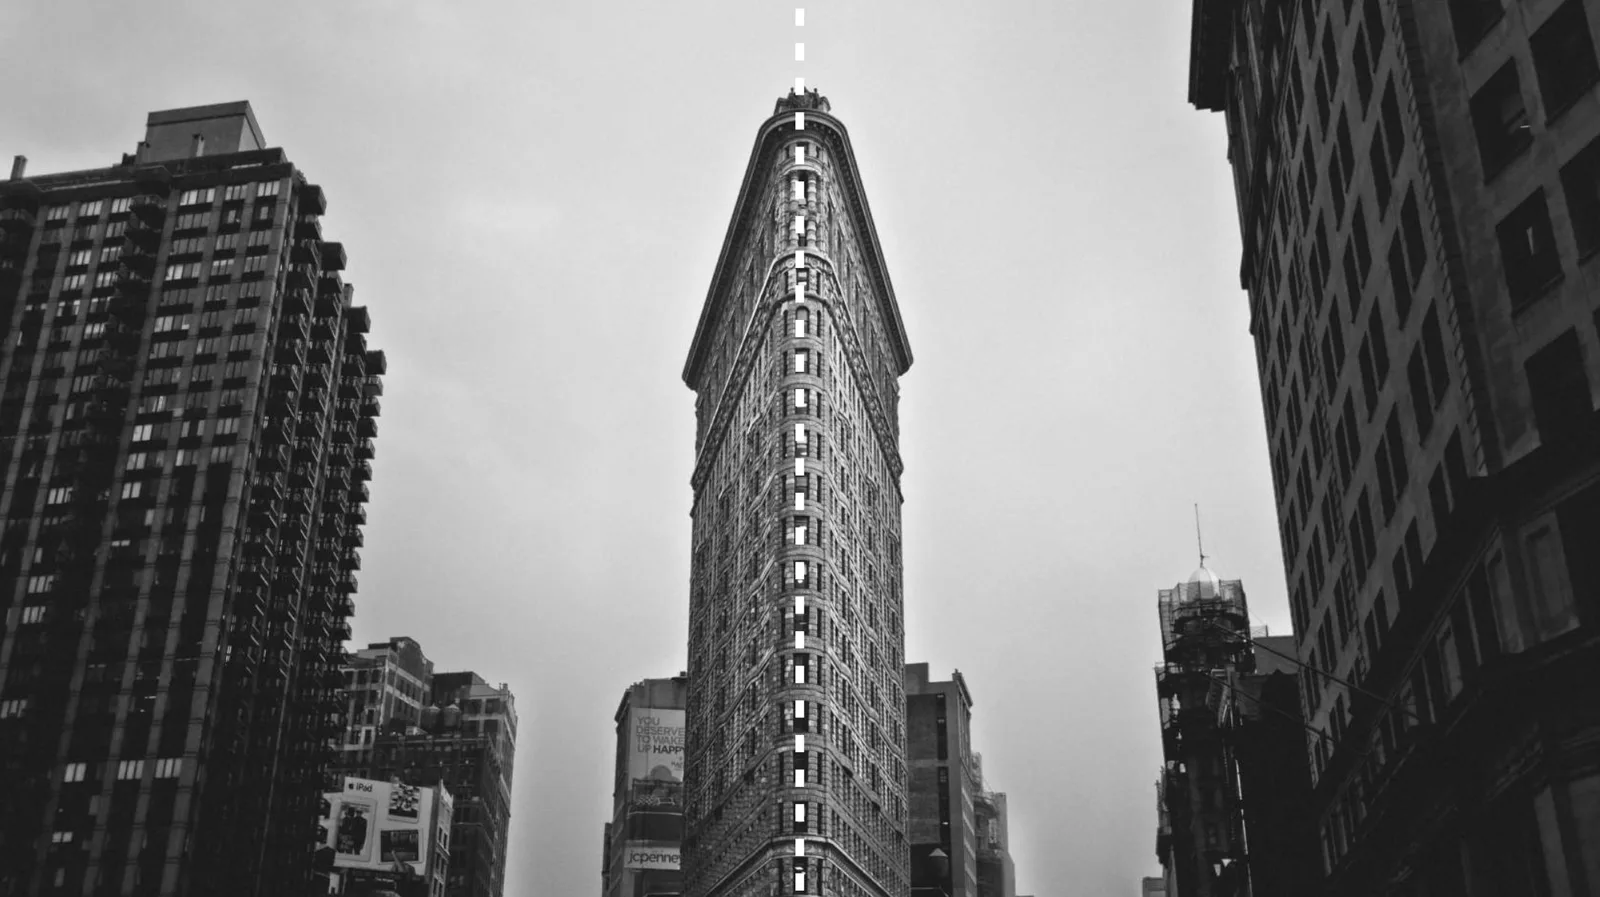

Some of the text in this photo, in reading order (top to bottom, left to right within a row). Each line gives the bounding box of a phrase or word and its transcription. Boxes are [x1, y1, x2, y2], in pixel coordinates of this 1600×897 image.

[637, 716, 660, 726] YOU
[636, 725, 685, 736] DESERVE
[636, 735, 685, 745] TO WAKE
[637, 744, 651, 753] UP
[357, 782, 373, 793] iPad
[629, 850, 680, 865] jcpenne
